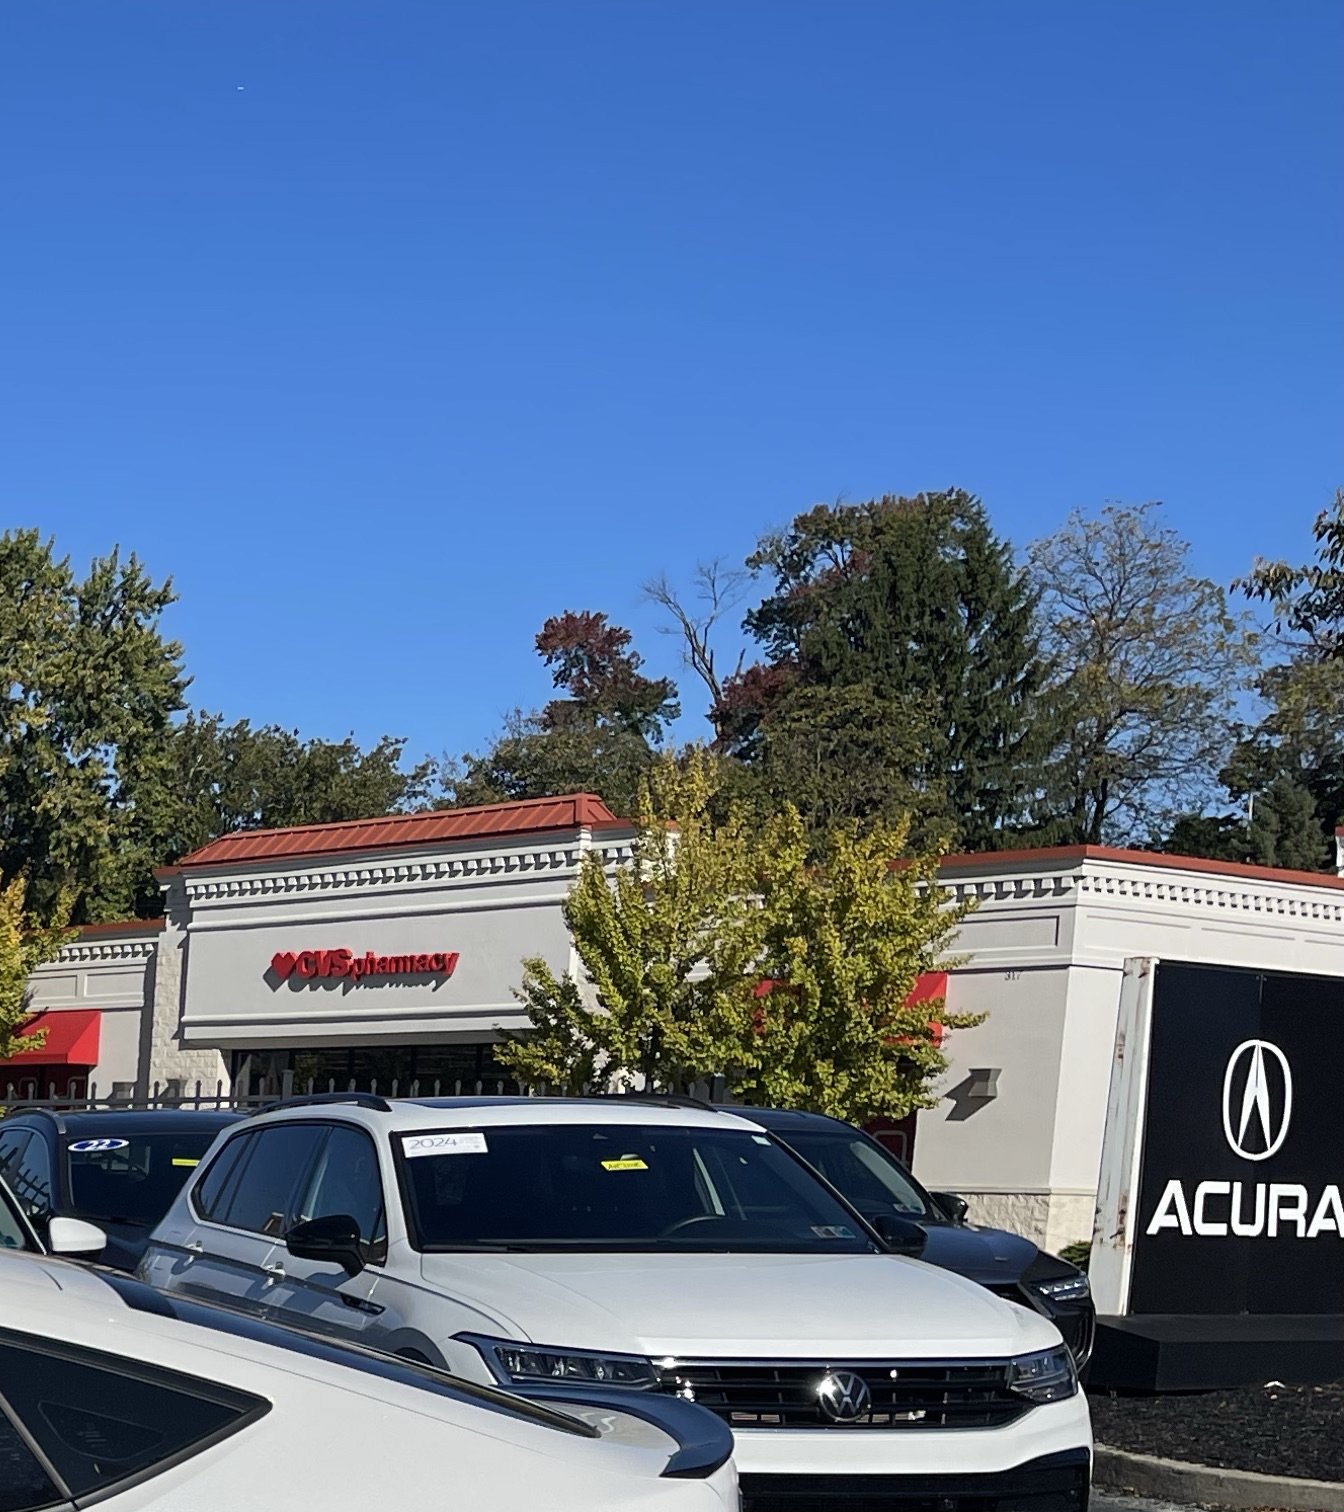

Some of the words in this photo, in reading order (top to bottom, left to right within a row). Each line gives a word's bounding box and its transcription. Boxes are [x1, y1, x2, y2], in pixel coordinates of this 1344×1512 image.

[295, 949, 352, 979] CVS
[352, 951, 460, 981] pharmacy
[85, 1139, 111, 1151] 22
[409, 1137, 458, 1150] 2024
[1145, 1179, 1344, 1238] ACURA
